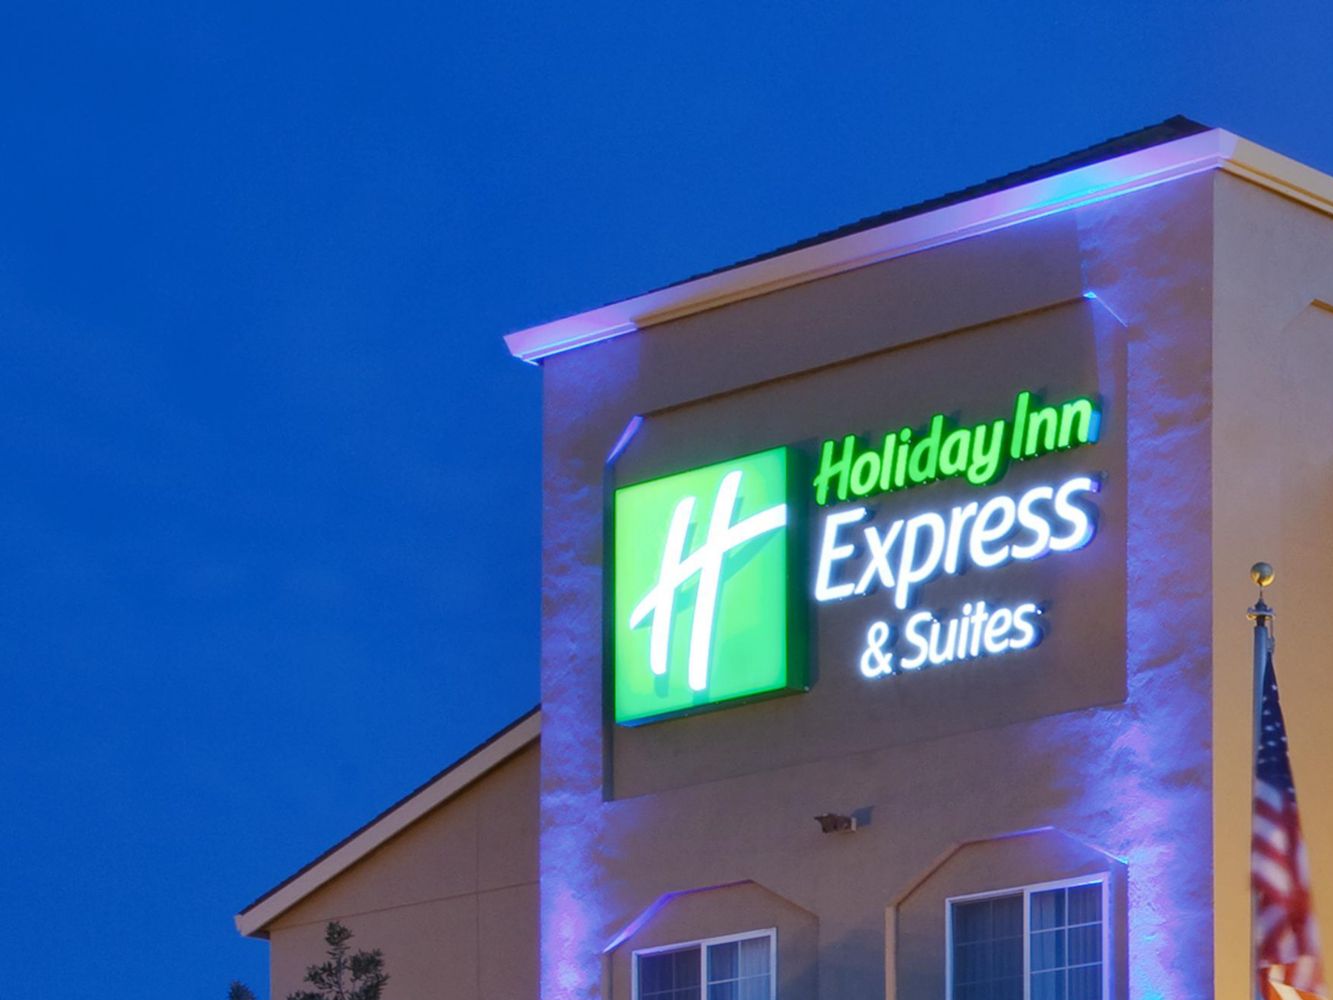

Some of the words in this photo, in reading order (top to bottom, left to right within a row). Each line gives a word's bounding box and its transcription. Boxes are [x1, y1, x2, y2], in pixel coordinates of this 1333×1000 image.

[813, 413, 1004, 504] Holiday
[1010, 391, 1094, 460] Inn
[814, 477, 1094, 608] Express
[860, 621, 894, 678] &
[900, 602, 1038, 668] Suites
